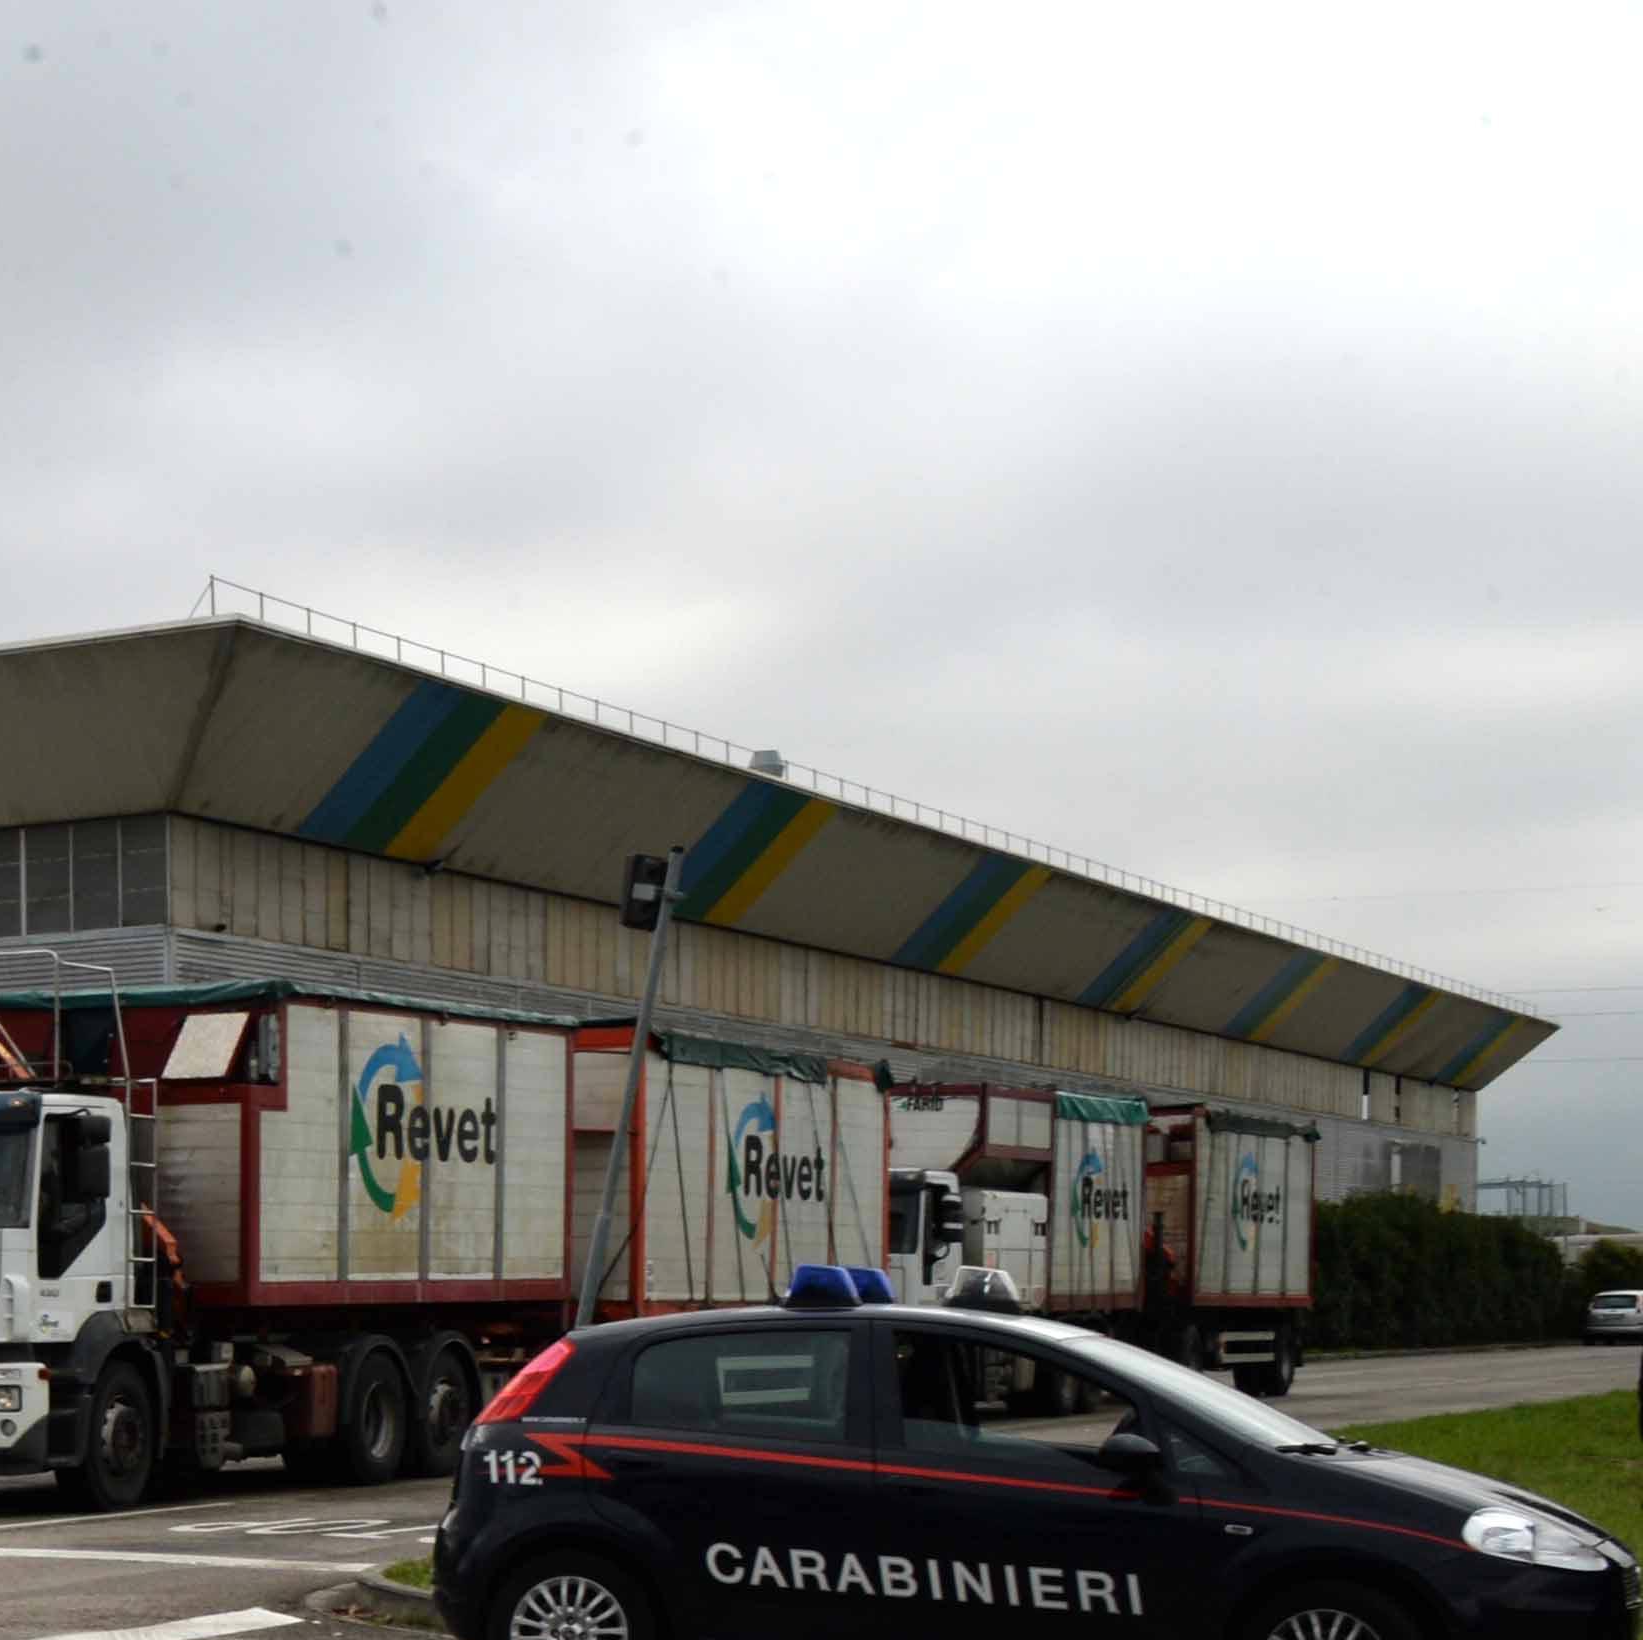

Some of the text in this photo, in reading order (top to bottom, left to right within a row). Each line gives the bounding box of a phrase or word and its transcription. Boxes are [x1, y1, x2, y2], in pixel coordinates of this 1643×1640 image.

[376, 1083, 497, 1165] Revet
[744, 1133, 825, 1202] Revet
[1081, 1175, 1129, 1221] Revet
[482, 1449, 544, 1486] 112
[705, 1541, 1144, 1616] CARABINIERI
